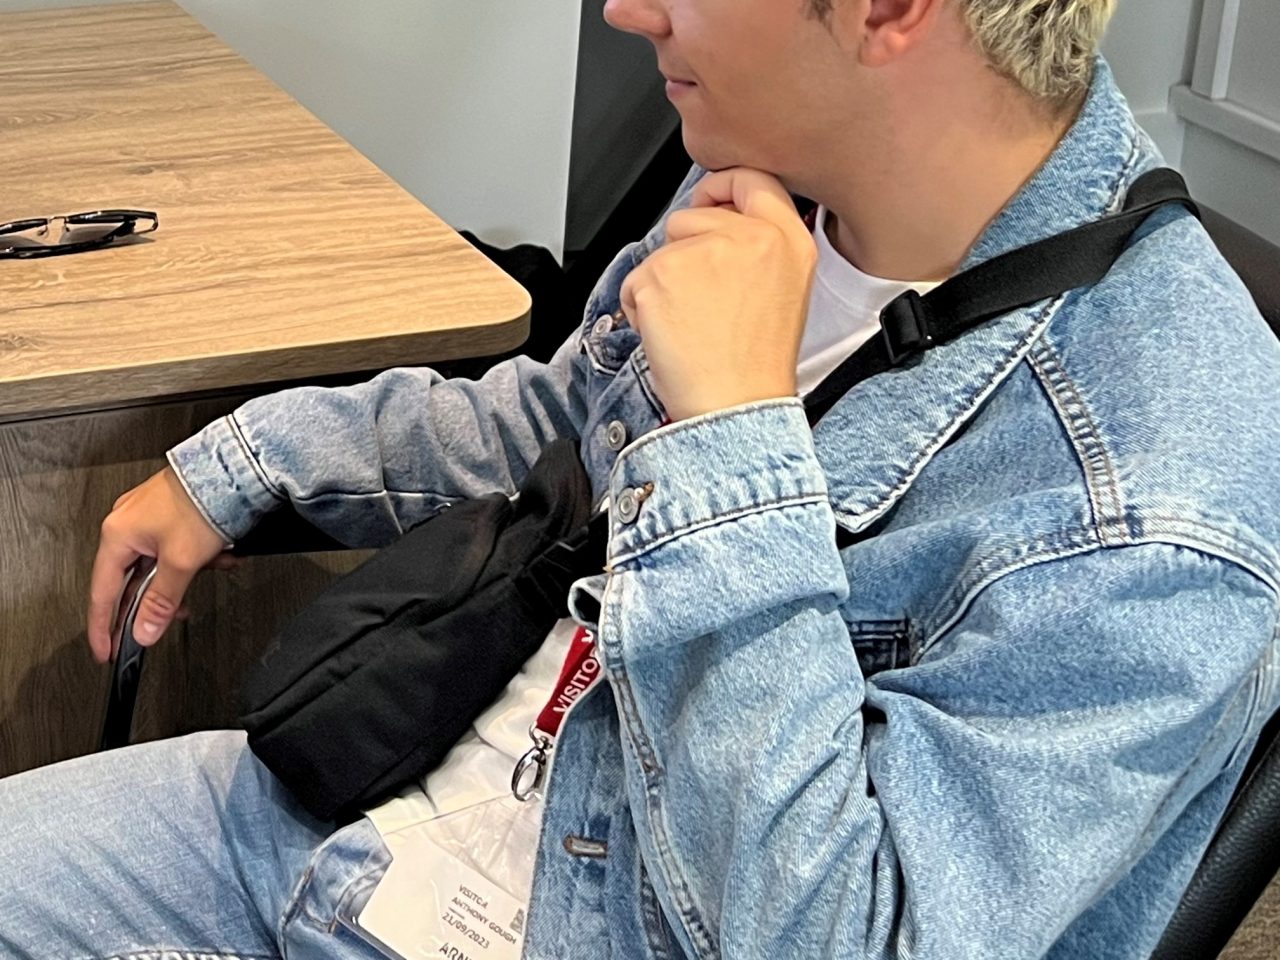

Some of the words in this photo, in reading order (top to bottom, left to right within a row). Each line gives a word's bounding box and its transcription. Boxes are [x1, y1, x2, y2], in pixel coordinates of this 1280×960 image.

[442, 912, 490, 949] 21/09/2023
[451, 897, 489, 924] ANTHONY
[488, 922, 517, 944] GOUGH
